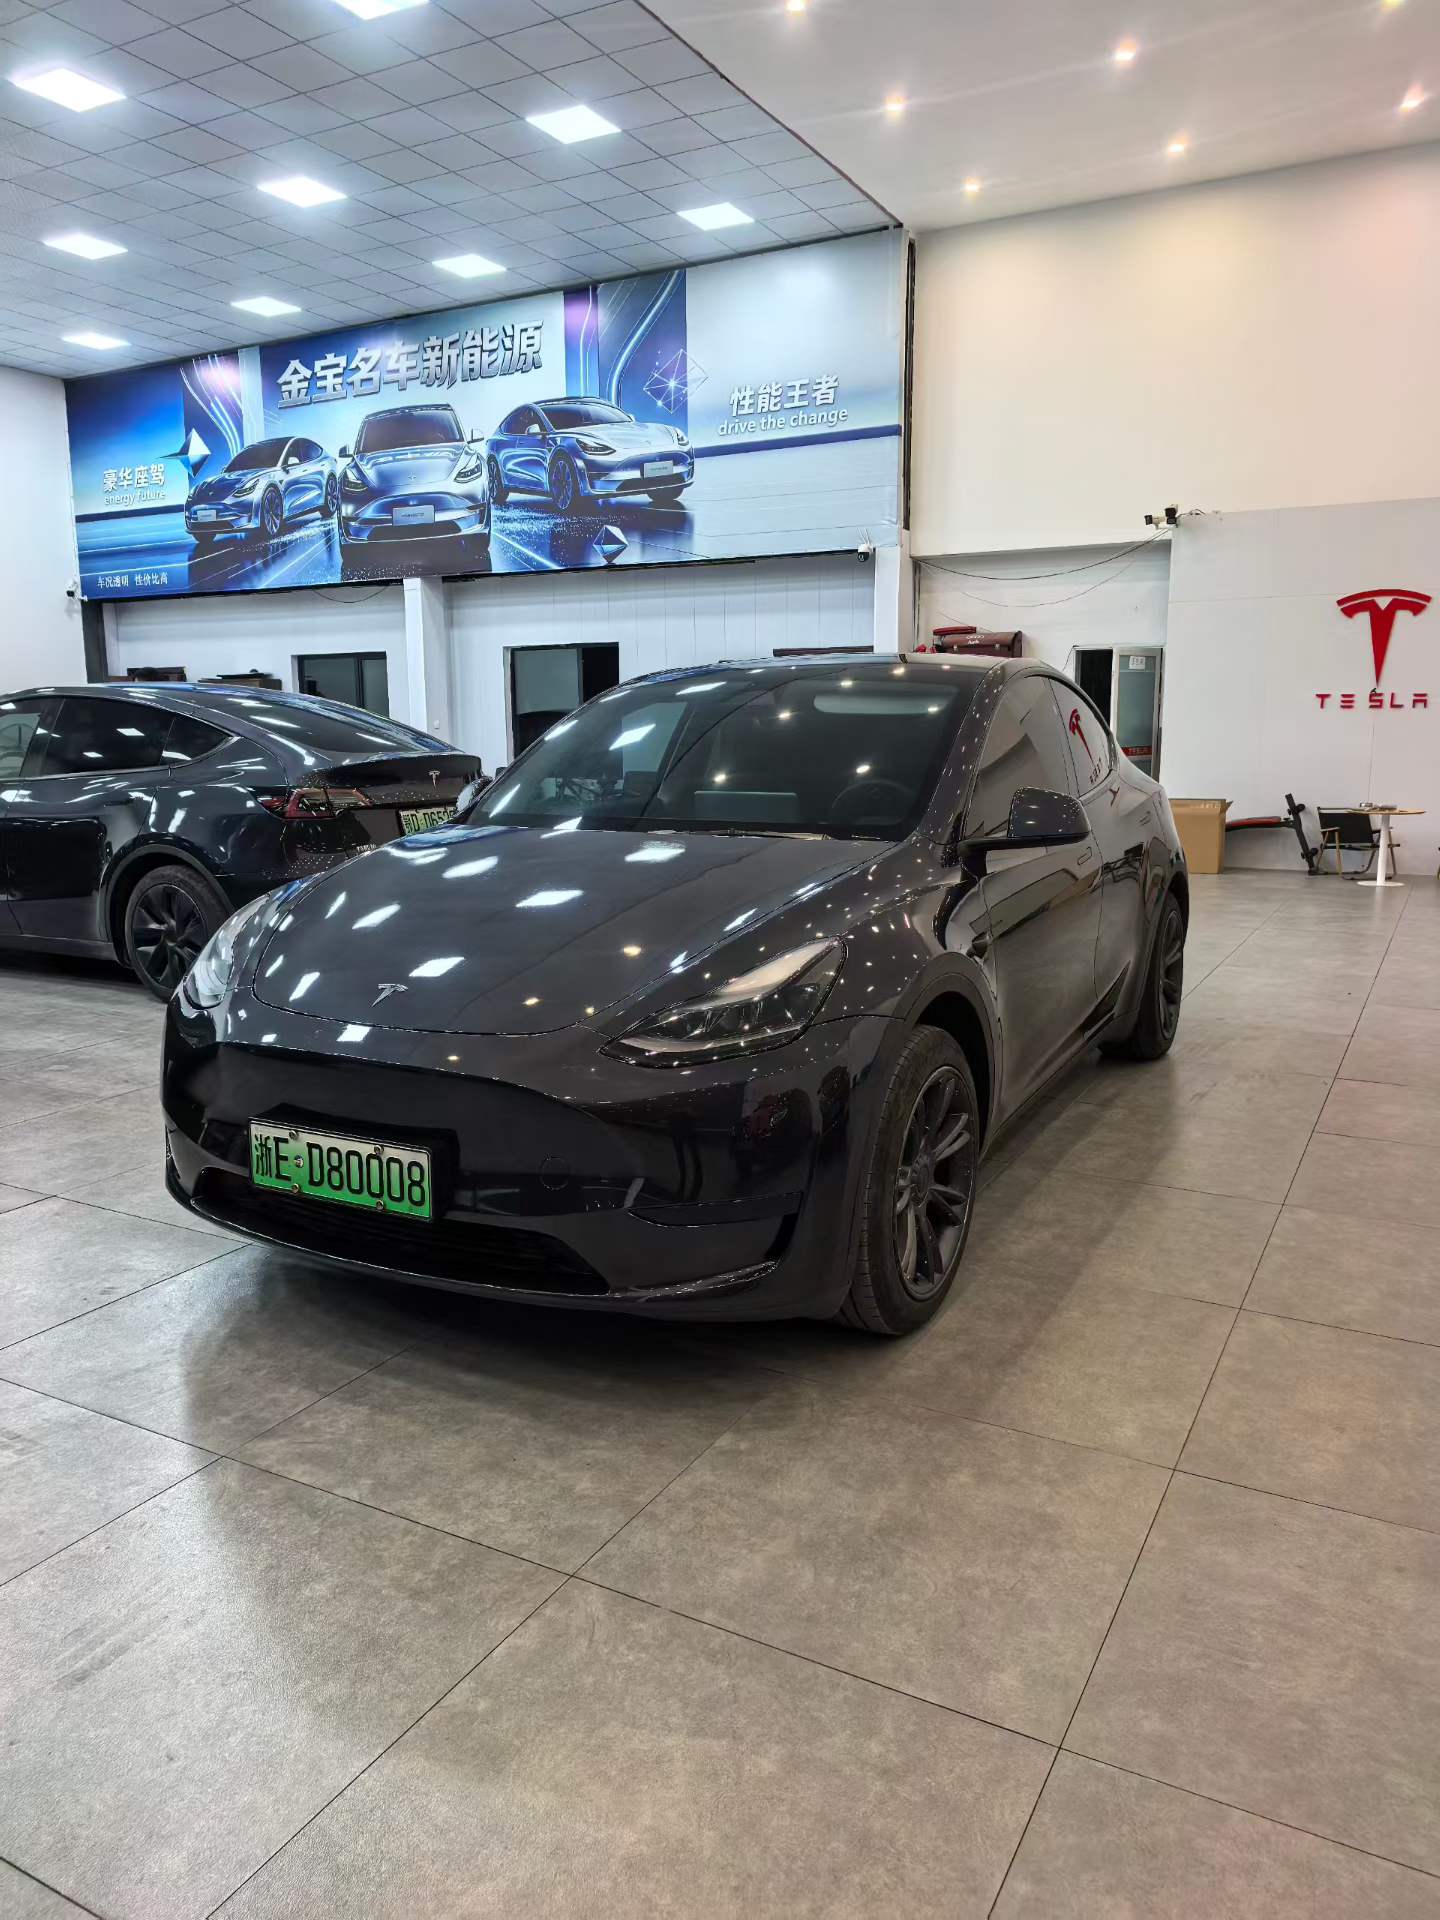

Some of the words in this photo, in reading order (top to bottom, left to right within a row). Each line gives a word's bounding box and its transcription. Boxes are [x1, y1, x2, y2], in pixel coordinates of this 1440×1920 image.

[277, 320, 543, 409] 金宝名车新能源
[729, 374, 839, 417] 性能王者
[718, 418, 756, 436] drive
[761, 412, 786, 431] the
[789, 407, 848, 428] change
[103, 463, 166, 492] 豪华座驾
[104, 492, 136, 506] energy
[138, 489, 166, 502] future
[97, 574, 129, 589] 车况透明
[134, 571, 168, 586] 性价比高
[1315, 692, 1428, 709] TESLA
